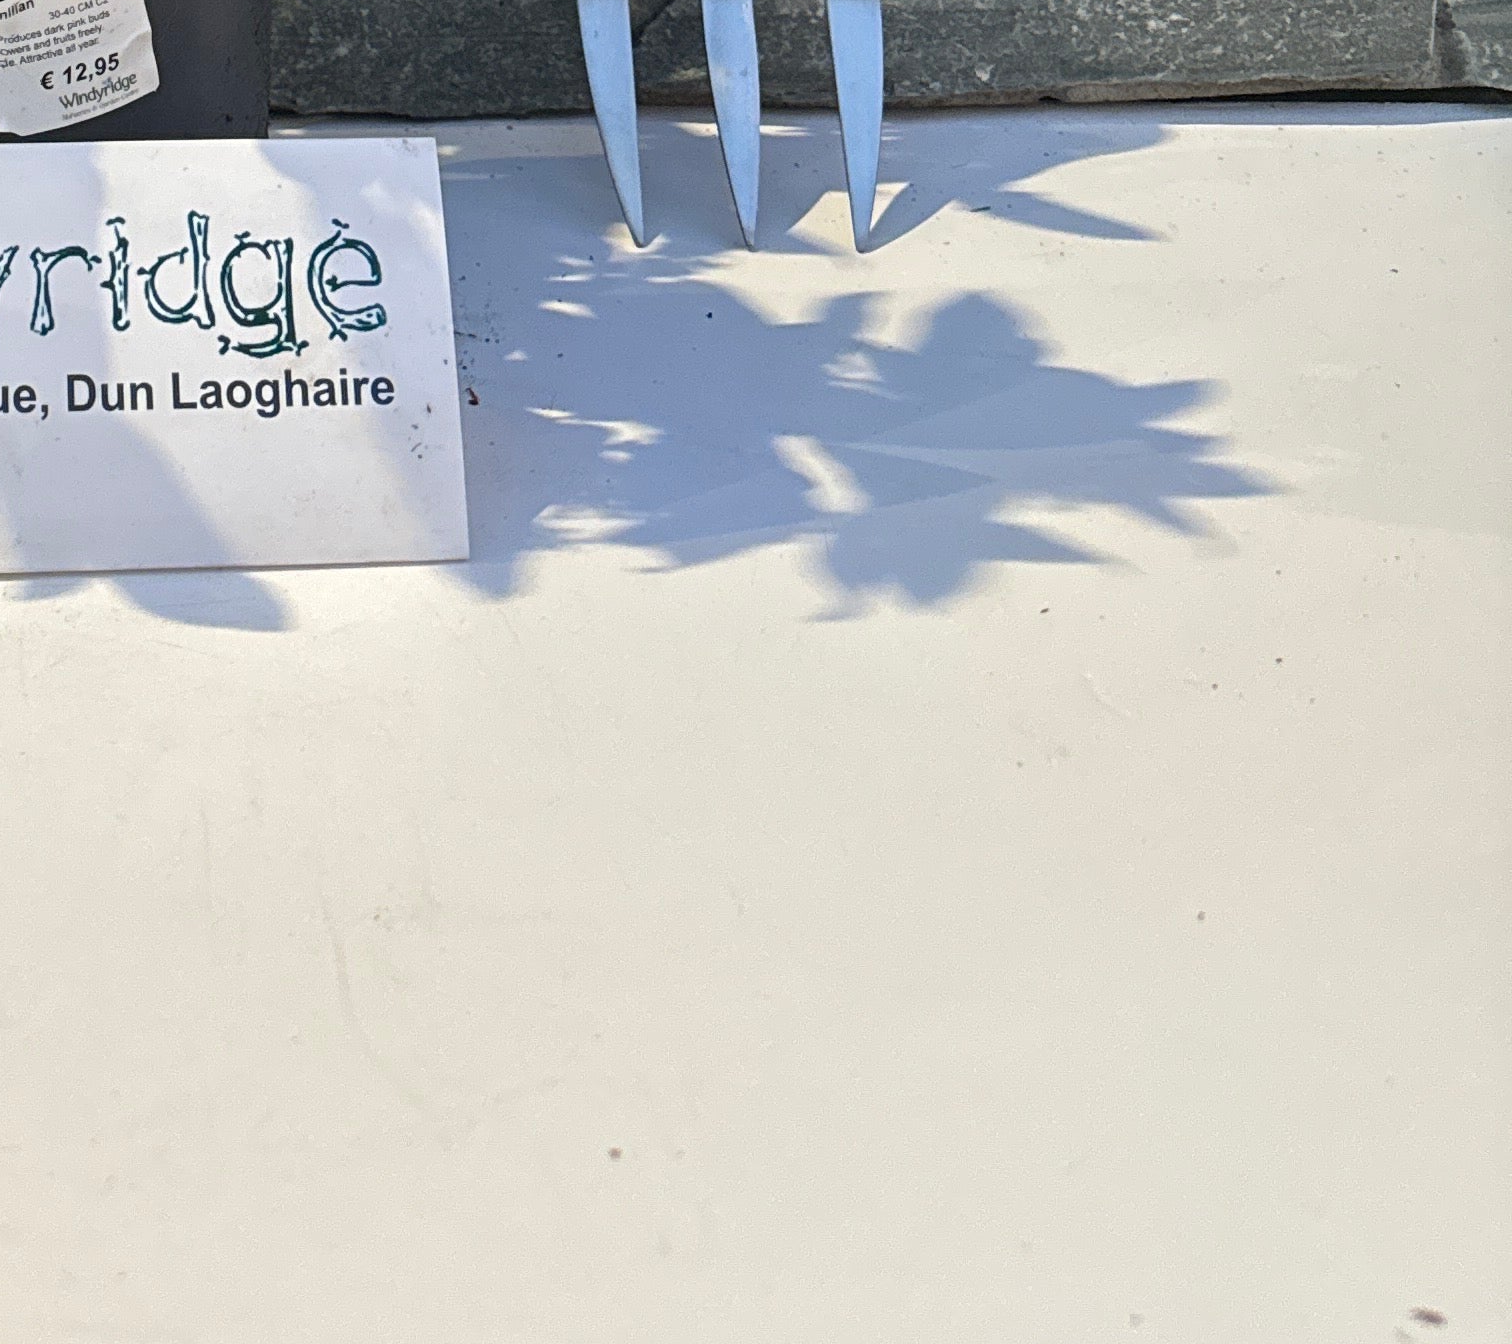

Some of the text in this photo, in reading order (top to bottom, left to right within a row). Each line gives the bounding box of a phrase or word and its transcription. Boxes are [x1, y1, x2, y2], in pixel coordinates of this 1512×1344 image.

[44, 24, 65, 36] dark
[67, 17, 86, 31] pink
[88, 10, 110, 23] buds
[48, 6, 75, 20] 30-40
[78, 0, 94, 12] CM
[20, 49, 63, 65] Attractive
[65, 43, 77, 54] all
[33, 39, 50, 50] and
[53, 33, 76, 46] fruits
[40, 52, 120, 90] € 12,95
[59, 73, 137, 109] Windyridge
[66, 373, 154, 411] Dun
[172, 367, 395, 418] Laoghaire
